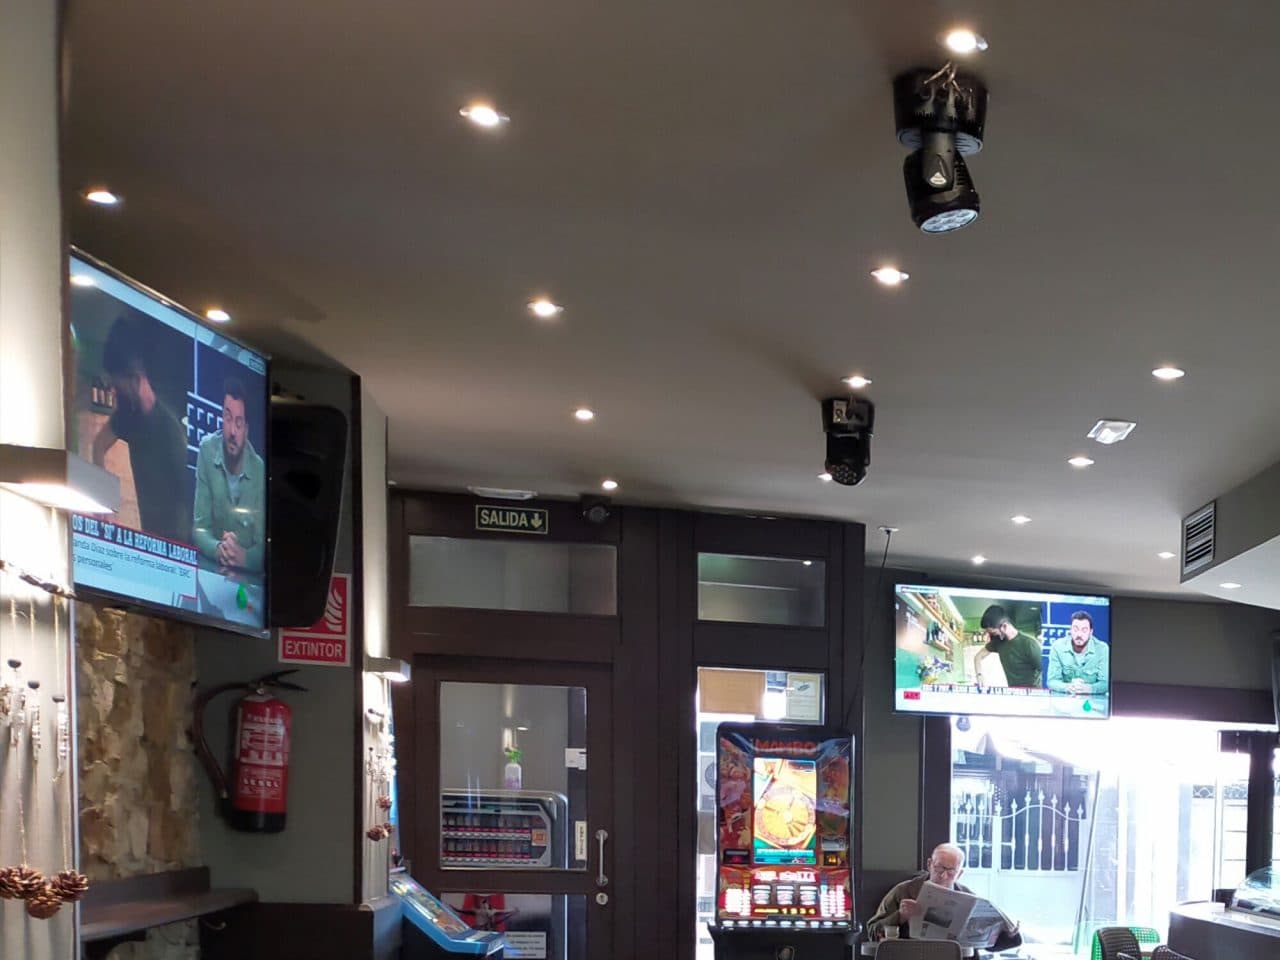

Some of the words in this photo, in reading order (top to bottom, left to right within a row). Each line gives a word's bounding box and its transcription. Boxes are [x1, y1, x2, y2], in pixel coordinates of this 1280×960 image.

[481, 509, 528, 527] SALIDA
[134, 532, 168, 556] REFORMA
[168, 543, 198, 565] LABORAL
[285, 640, 342, 657] EXTINTOR
